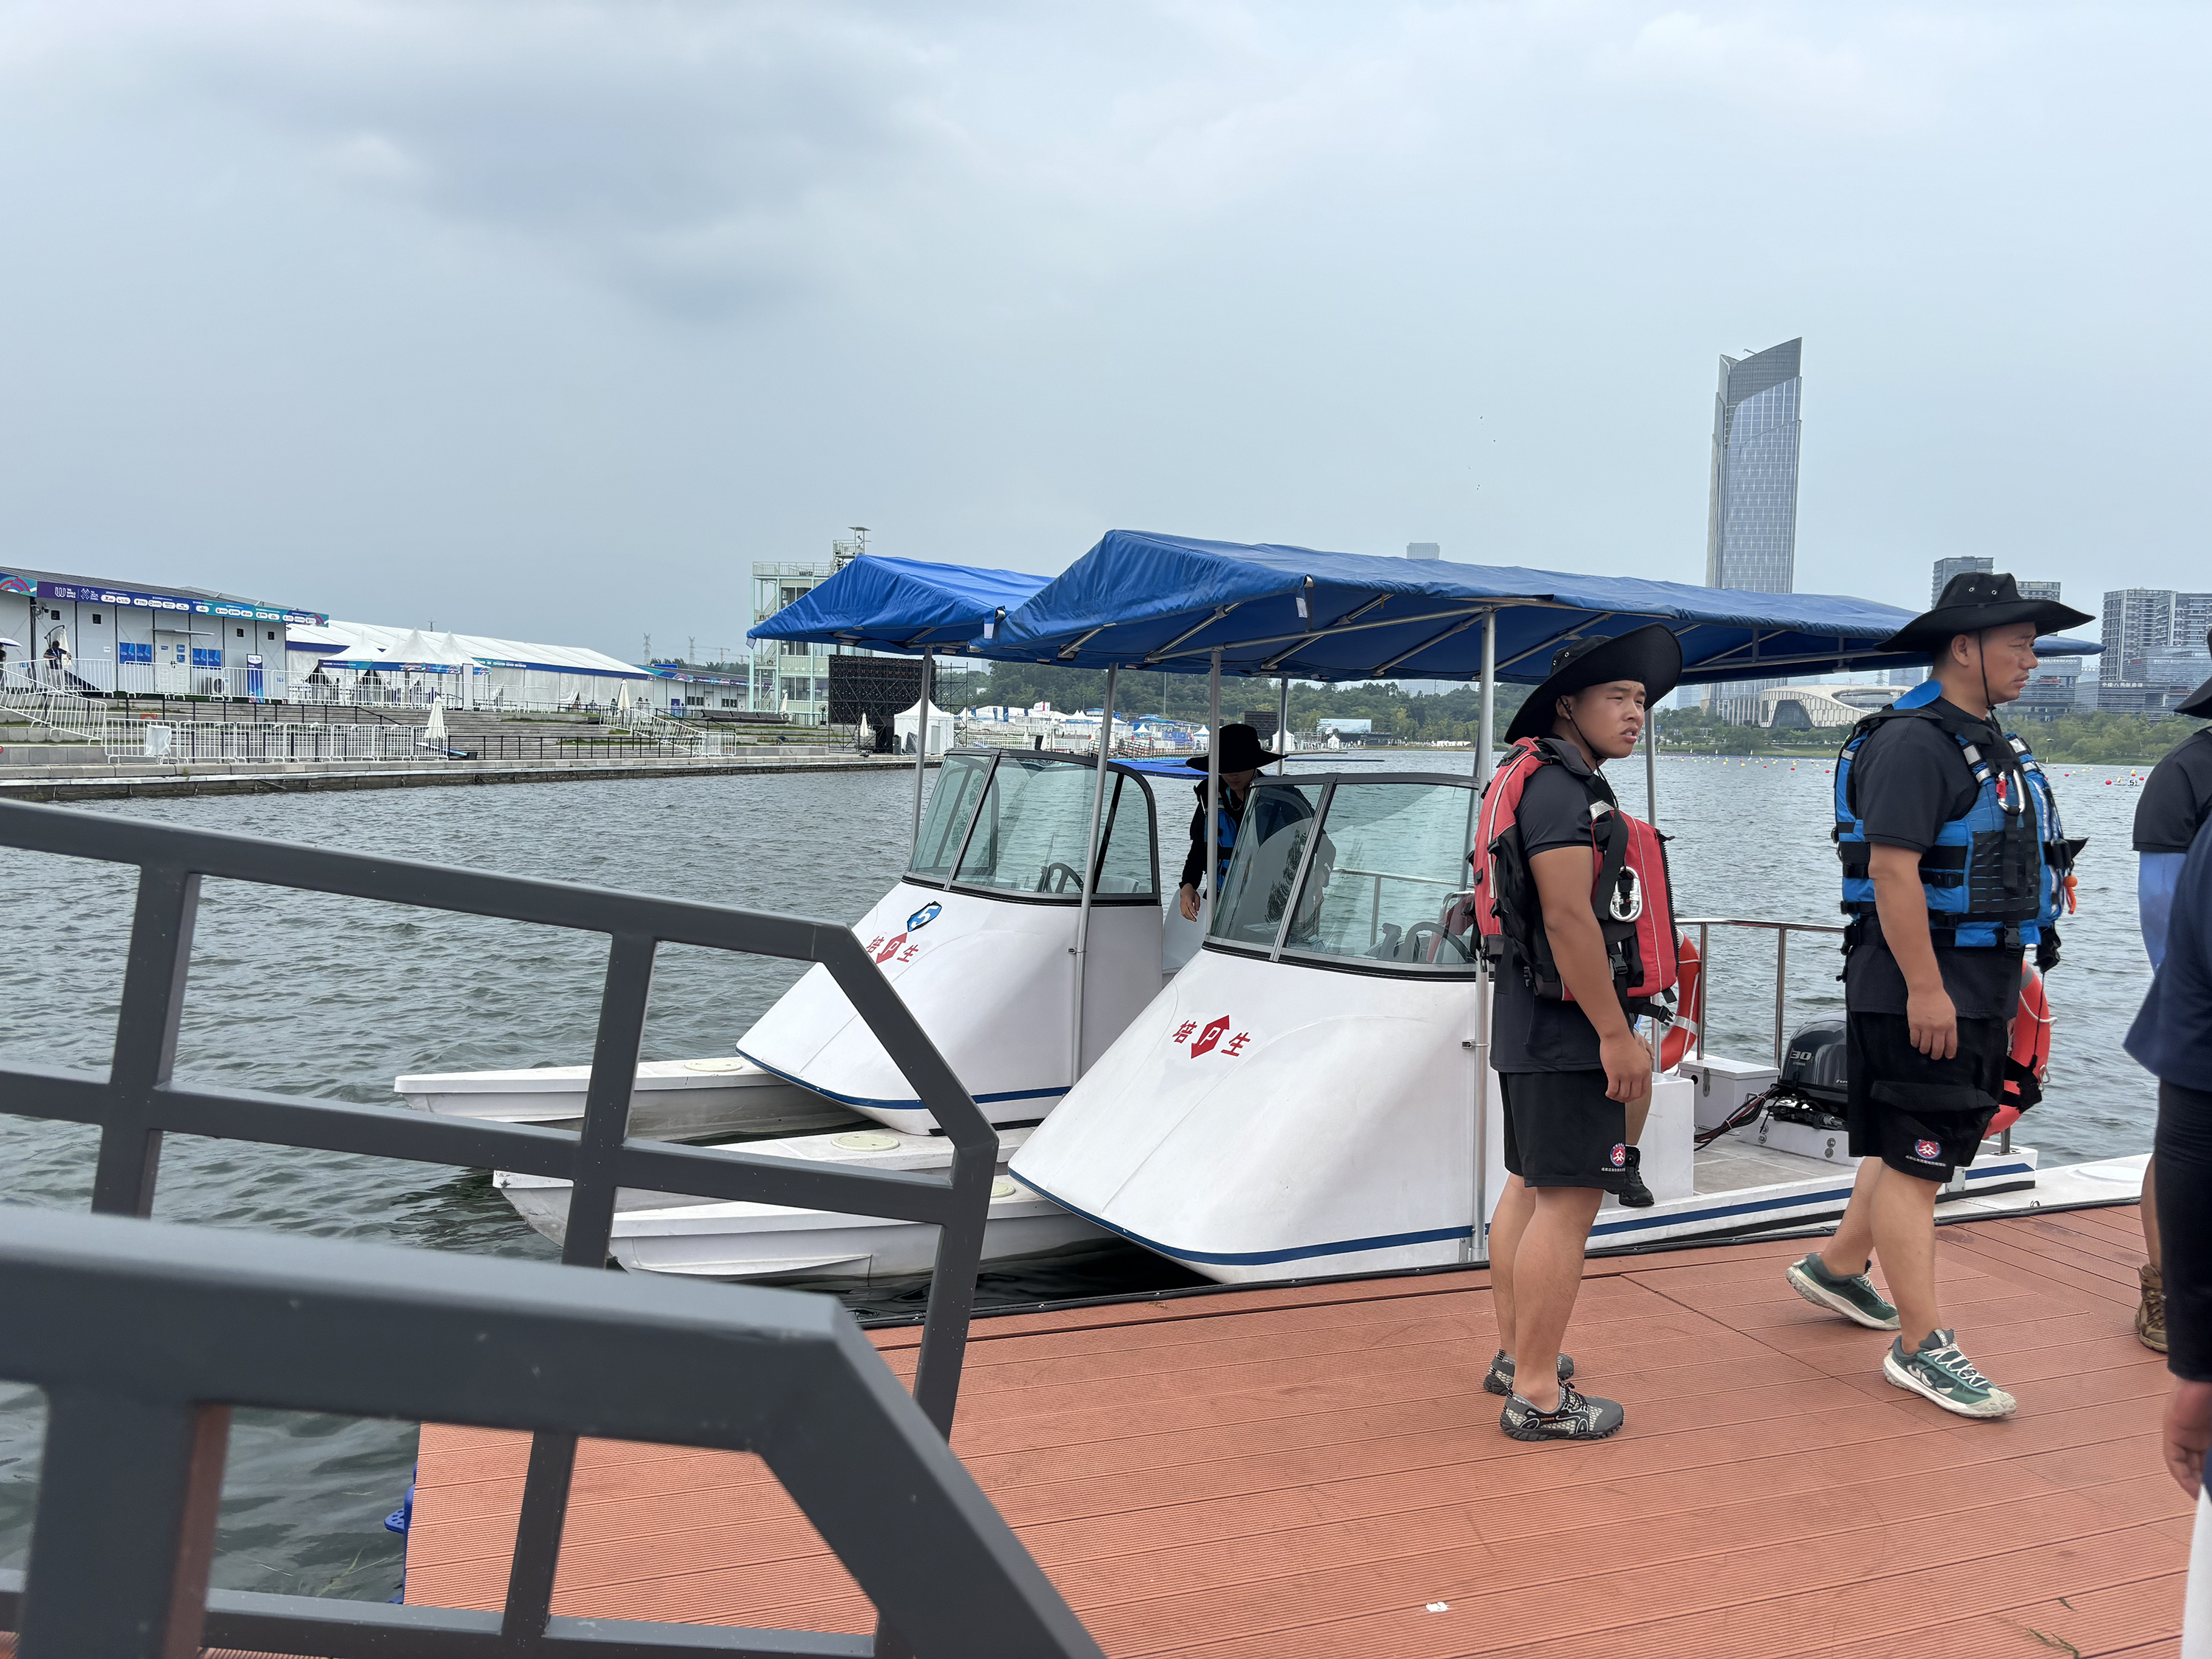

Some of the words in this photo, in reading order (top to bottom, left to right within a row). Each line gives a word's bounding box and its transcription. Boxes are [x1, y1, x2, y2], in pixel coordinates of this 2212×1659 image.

[911, 905, 939, 928] 5
[897, 945, 919, 963] 生
[1220, 1032, 1251, 1057] 生
[1790, 1051, 1812, 1060] 30
